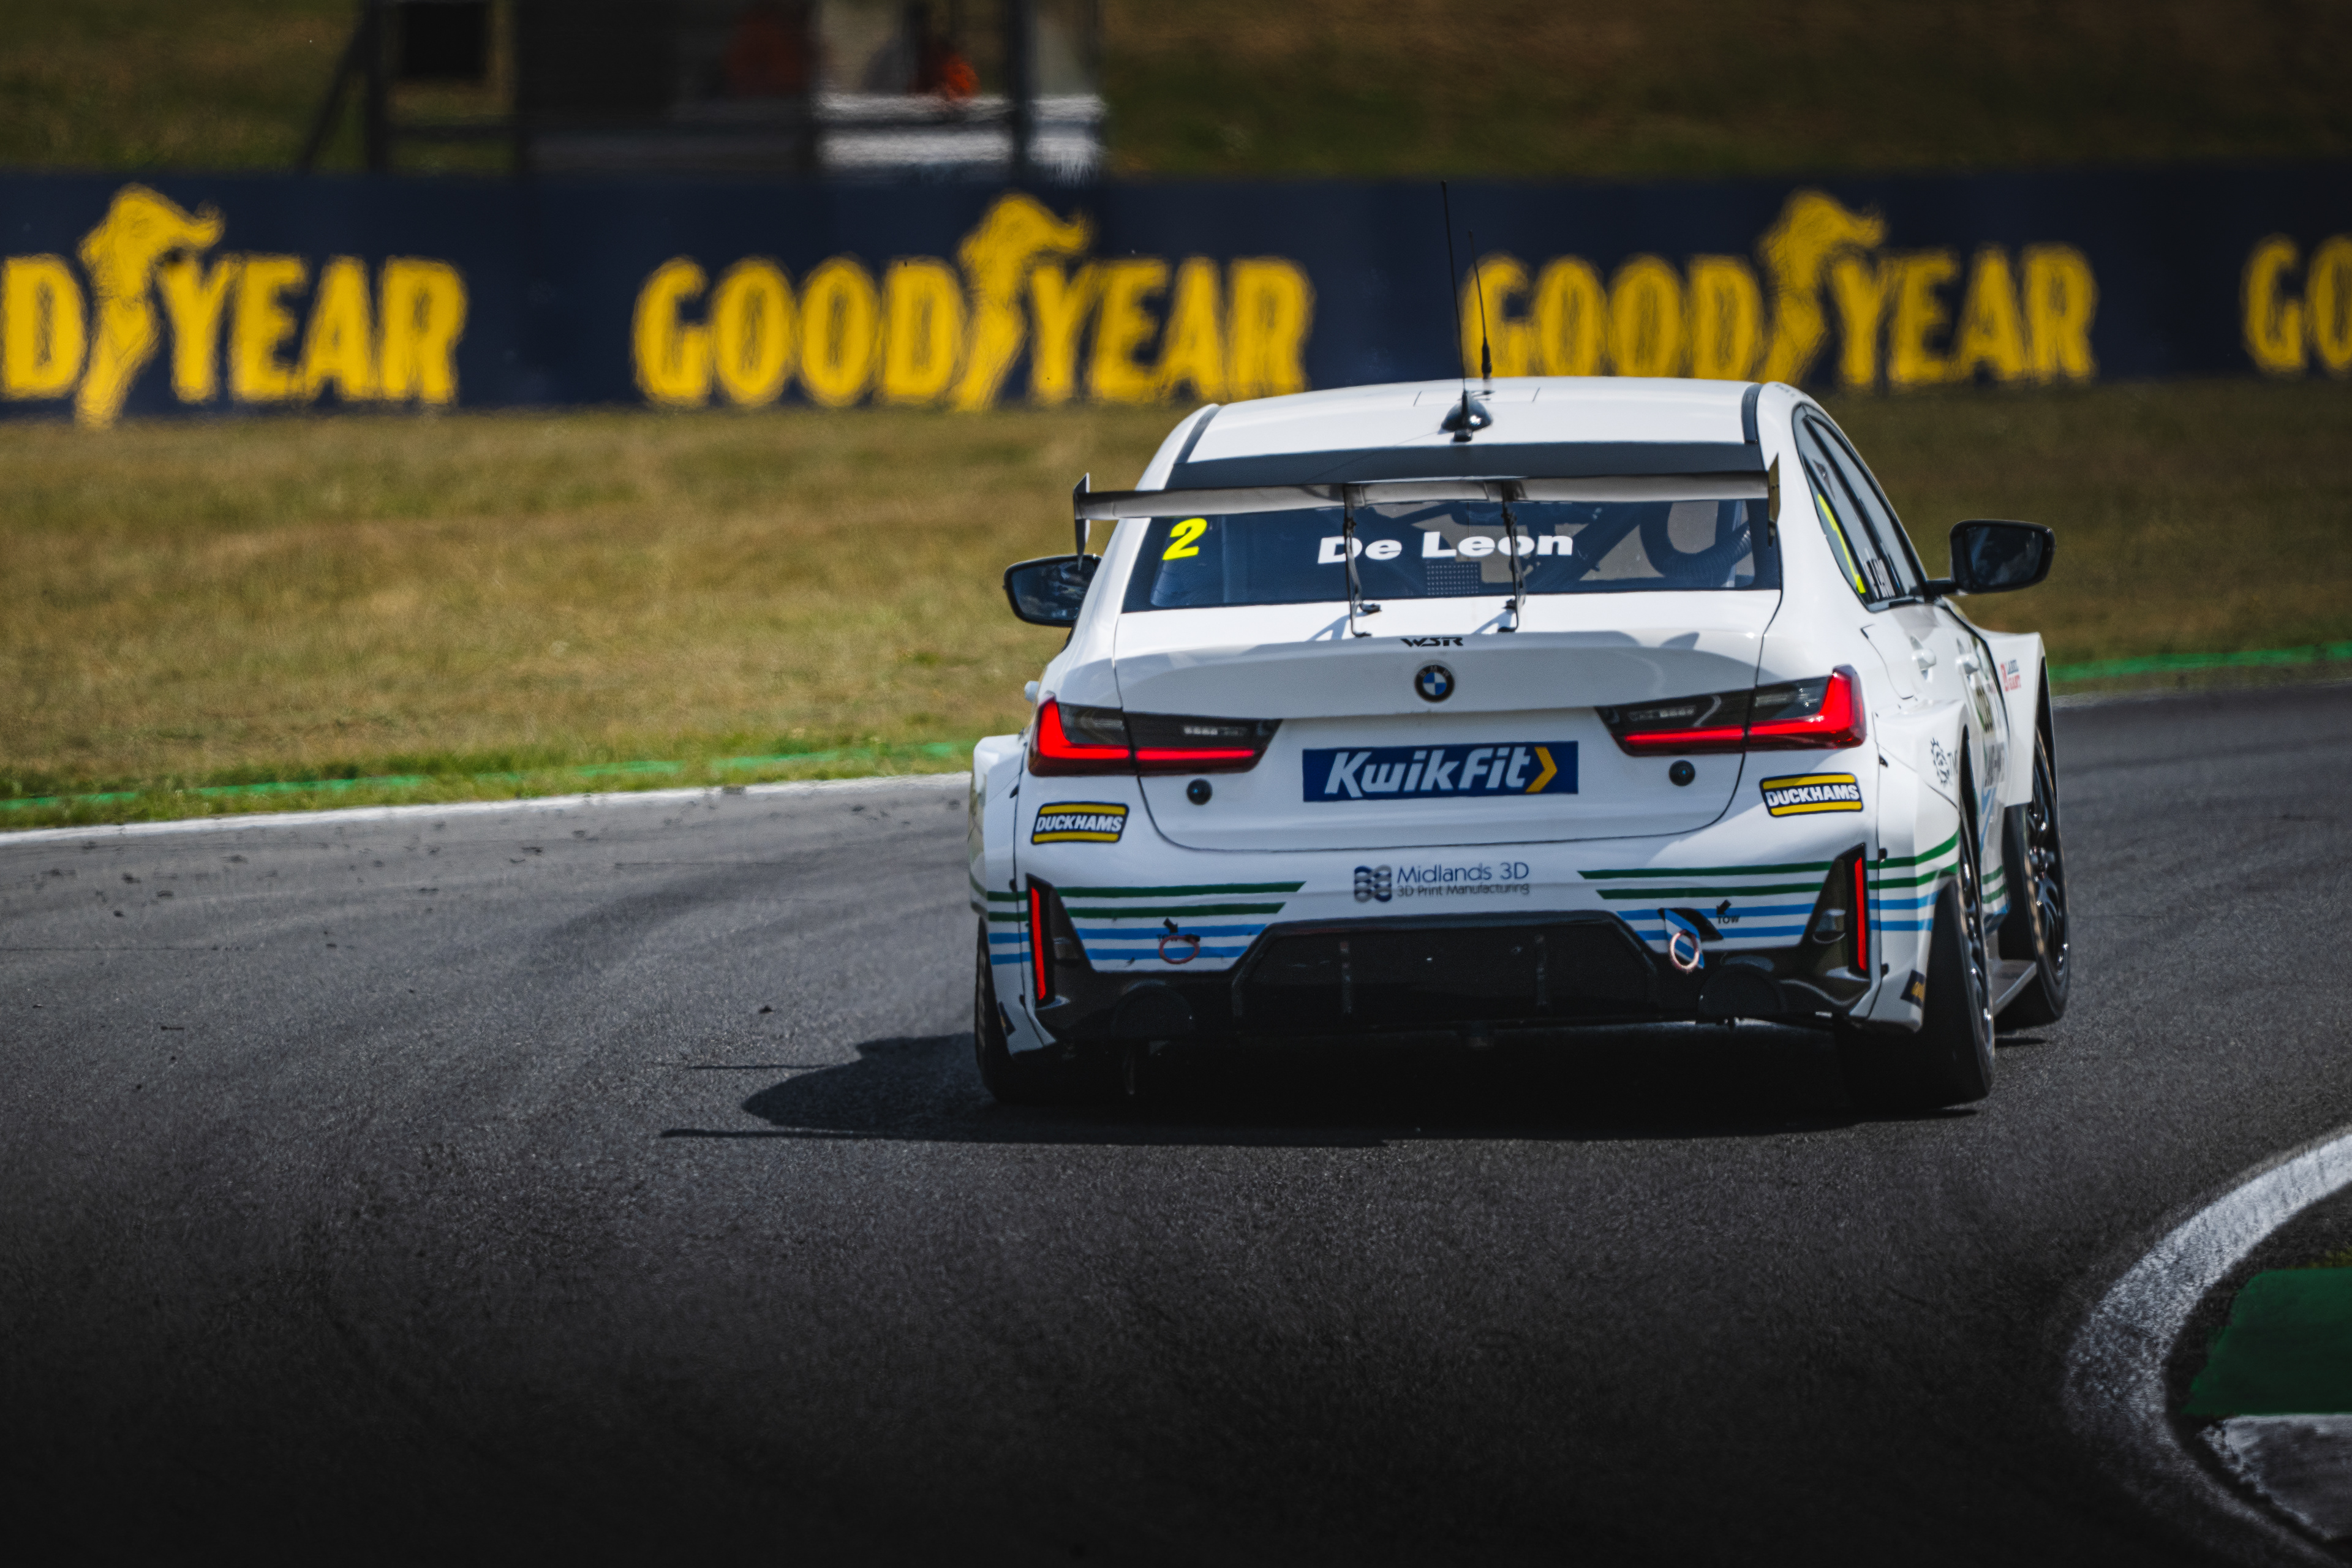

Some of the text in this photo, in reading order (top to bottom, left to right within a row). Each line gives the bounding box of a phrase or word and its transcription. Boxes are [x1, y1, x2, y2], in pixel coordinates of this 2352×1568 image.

[1461, 241, 2098, 388] GOODYEAR
[632, 254, 1316, 405] GOODYEAR
[1163, 518, 1207, 560] 2
[1317, 531, 1574, 564] De Leon
[1400, 636, 1464, 647] WSR
[1765, 784, 1860, 807] DUCKHAMS
[1035, 815, 1123, 832] DUCKHAMS
[1396, 862, 1530, 884] Midlands 3D
[1396, 882, 1531, 898] 3D Print Manufacturing
[1716, 914, 1741, 924] TOW
